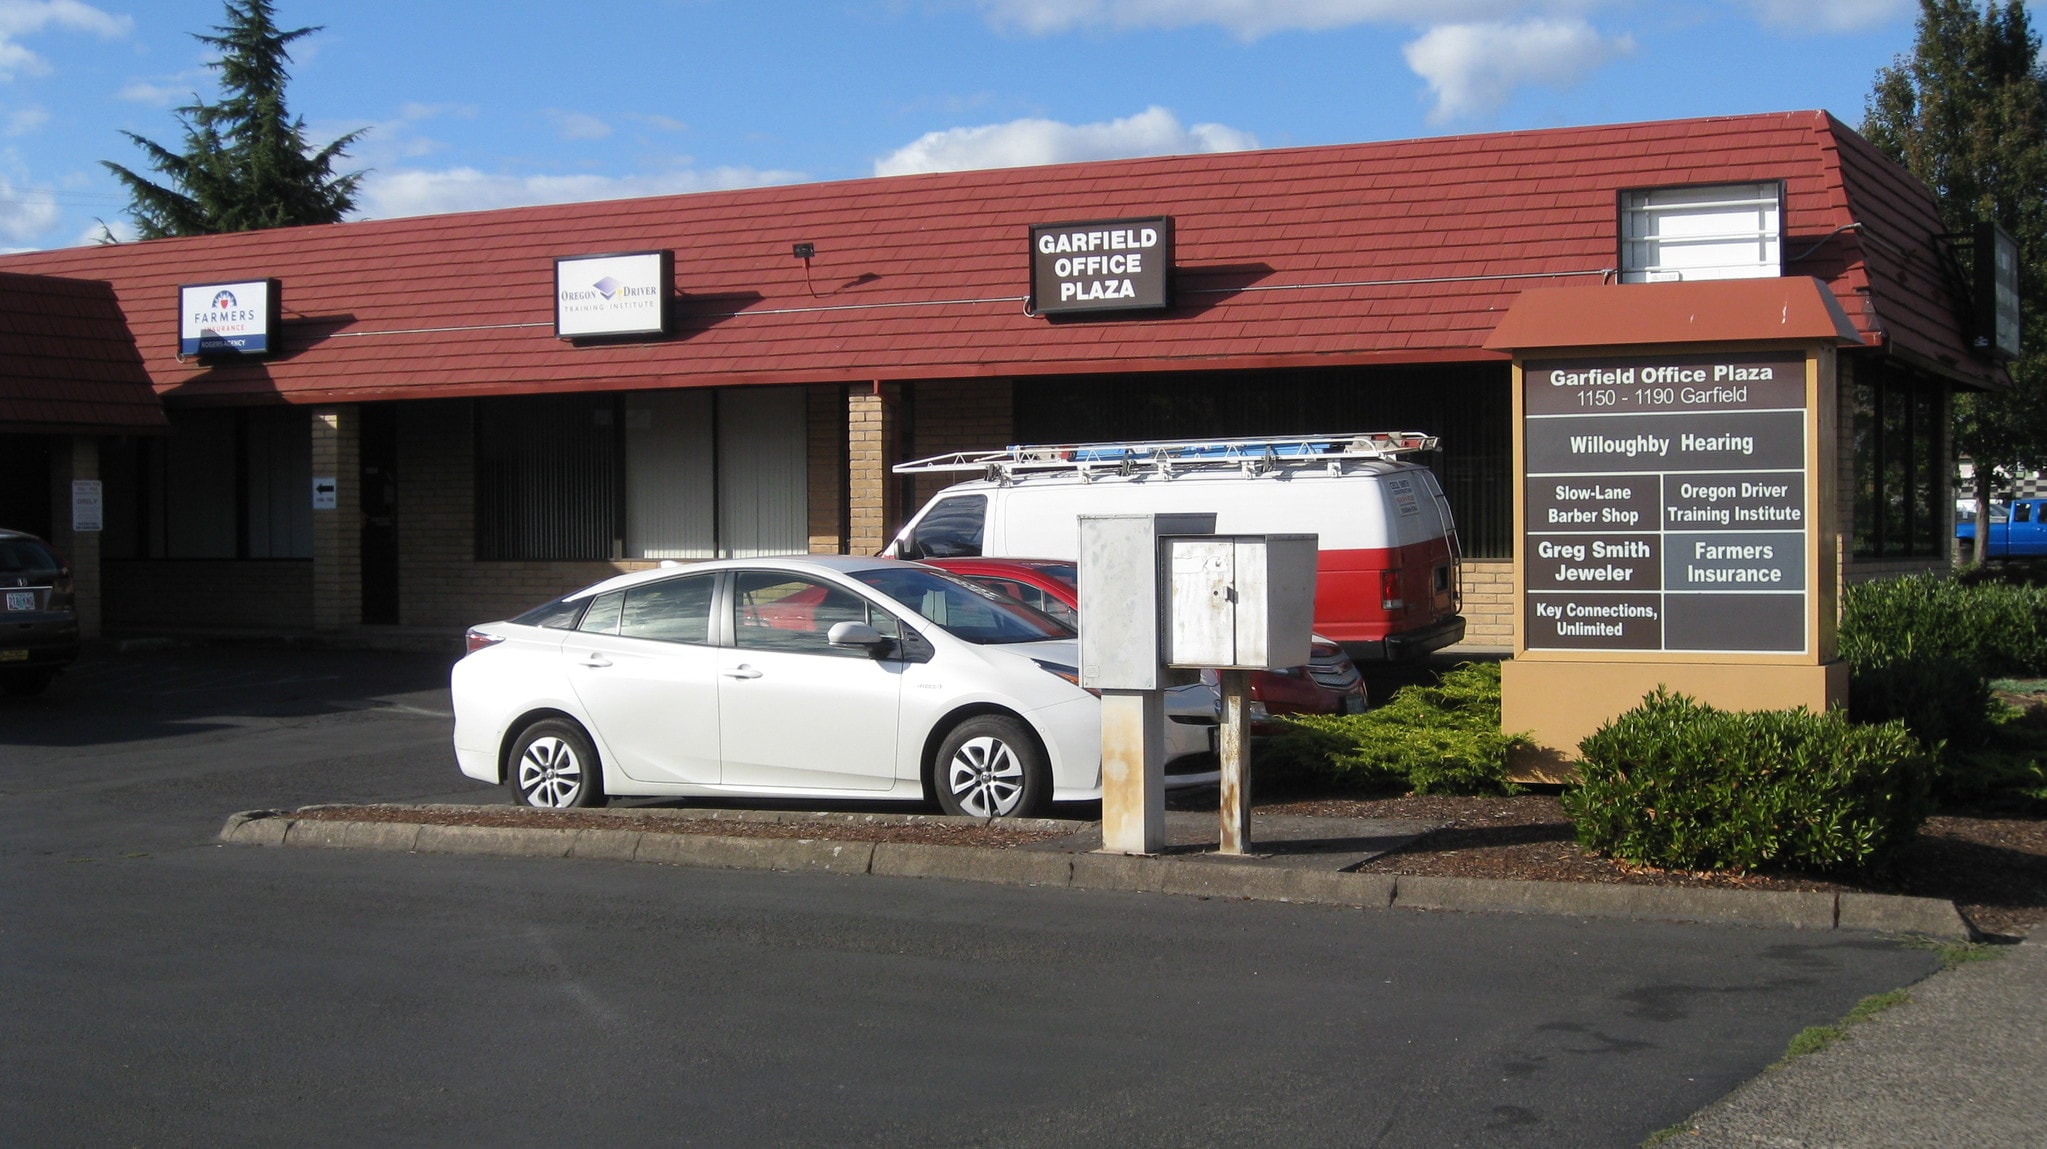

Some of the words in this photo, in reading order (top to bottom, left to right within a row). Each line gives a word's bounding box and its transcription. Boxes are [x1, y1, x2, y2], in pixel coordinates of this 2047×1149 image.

[1038, 228, 1157, 254] GARFIELD
[1054, 254, 1142, 277] OFFICE
[561, 290, 597, 301] OREGON
[623, 286, 657, 297] DRIVER
[1061, 279, 1136, 301] PLAZA
[565, 304, 604, 312] TRAINING
[610, 301, 655, 310] INSTITUTE
[194, 310, 254, 324] FARMERS
[205, 324, 245, 332] INSURANCE
[1550, 368, 1634, 386] Garfield
[1641, 367, 1707, 383] Office
[1714, 364, 1773, 381] Plaza
[1577, 389, 1616, 406] 1150
[1635, 388, 1674, 405] 1190
[1680, 386, 1747, 404] Garfield
[1570, 435, 1670, 456] Willoughby
[1681, 433, 1753, 455] Hearing
[1555, 485, 1632, 500] Slow-Lane
[1681, 483, 1736, 502] Oregon
[1741, 483, 1788, 498] Driver
[1548, 508, 1598, 523] Barber
[1602, 508, 1639, 526] Shop
[1668, 506, 1730, 524] Training
[1735, 506, 1801, 521] Institute
[1538, 542, 1586, 561] Greg
[1592, 541, 1650, 558] Smith
[1695, 542, 1774, 560] Farmers
[1555, 564, 1633, 582] Jeweler
[1688, 565, 1782, 583] Insurance
[1536, 603, 1562, 620] Key
[1566, 603, 1658, 620] Connections,
[1557, 622, 1623, 636] Unlimited
